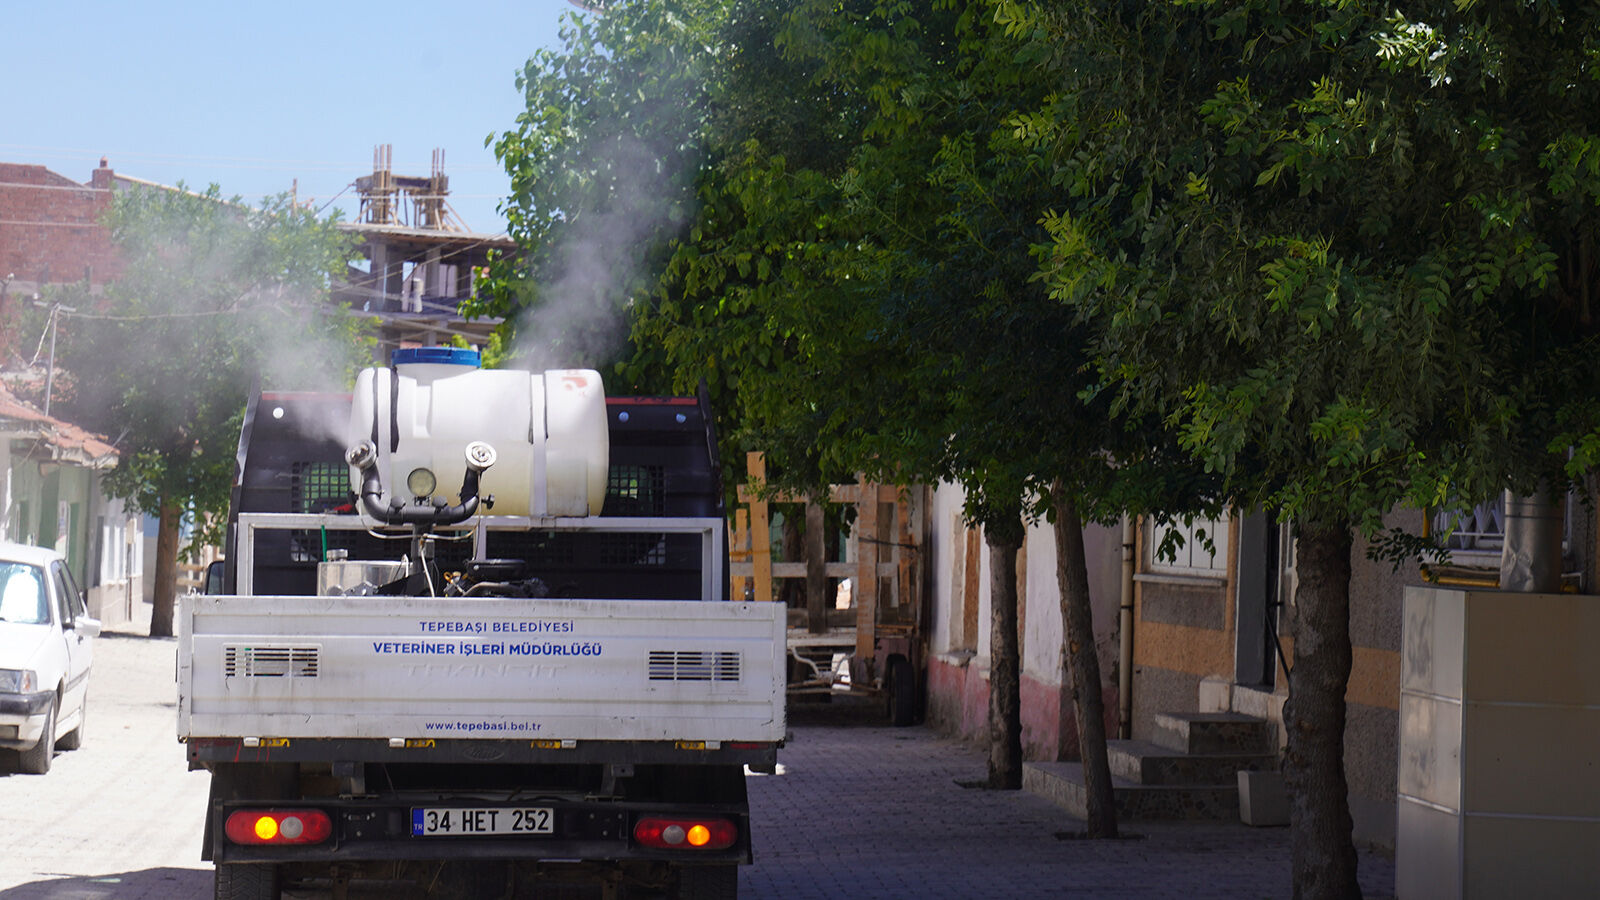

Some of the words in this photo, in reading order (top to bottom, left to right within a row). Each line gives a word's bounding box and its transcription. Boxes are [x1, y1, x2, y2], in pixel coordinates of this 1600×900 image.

[419, 621, 487, 634] TEPEBAŞI
[493, 620, 574, 632] BELEDİYESİ
[373, 641, 455, 655] VETERİNER
[460, 641, 505, 657] İŞLERİ
[509, 642, 602, 656] MÜDÜRLÜĞÜ
[425, 721, 542, 732] www.tepebasi.bel.tr
[413, 823, 423, 831] TR
[427, 811, 451, 832] 34
[462, 811, 499, 832] HET
[512, 810, 549, 831] 252
